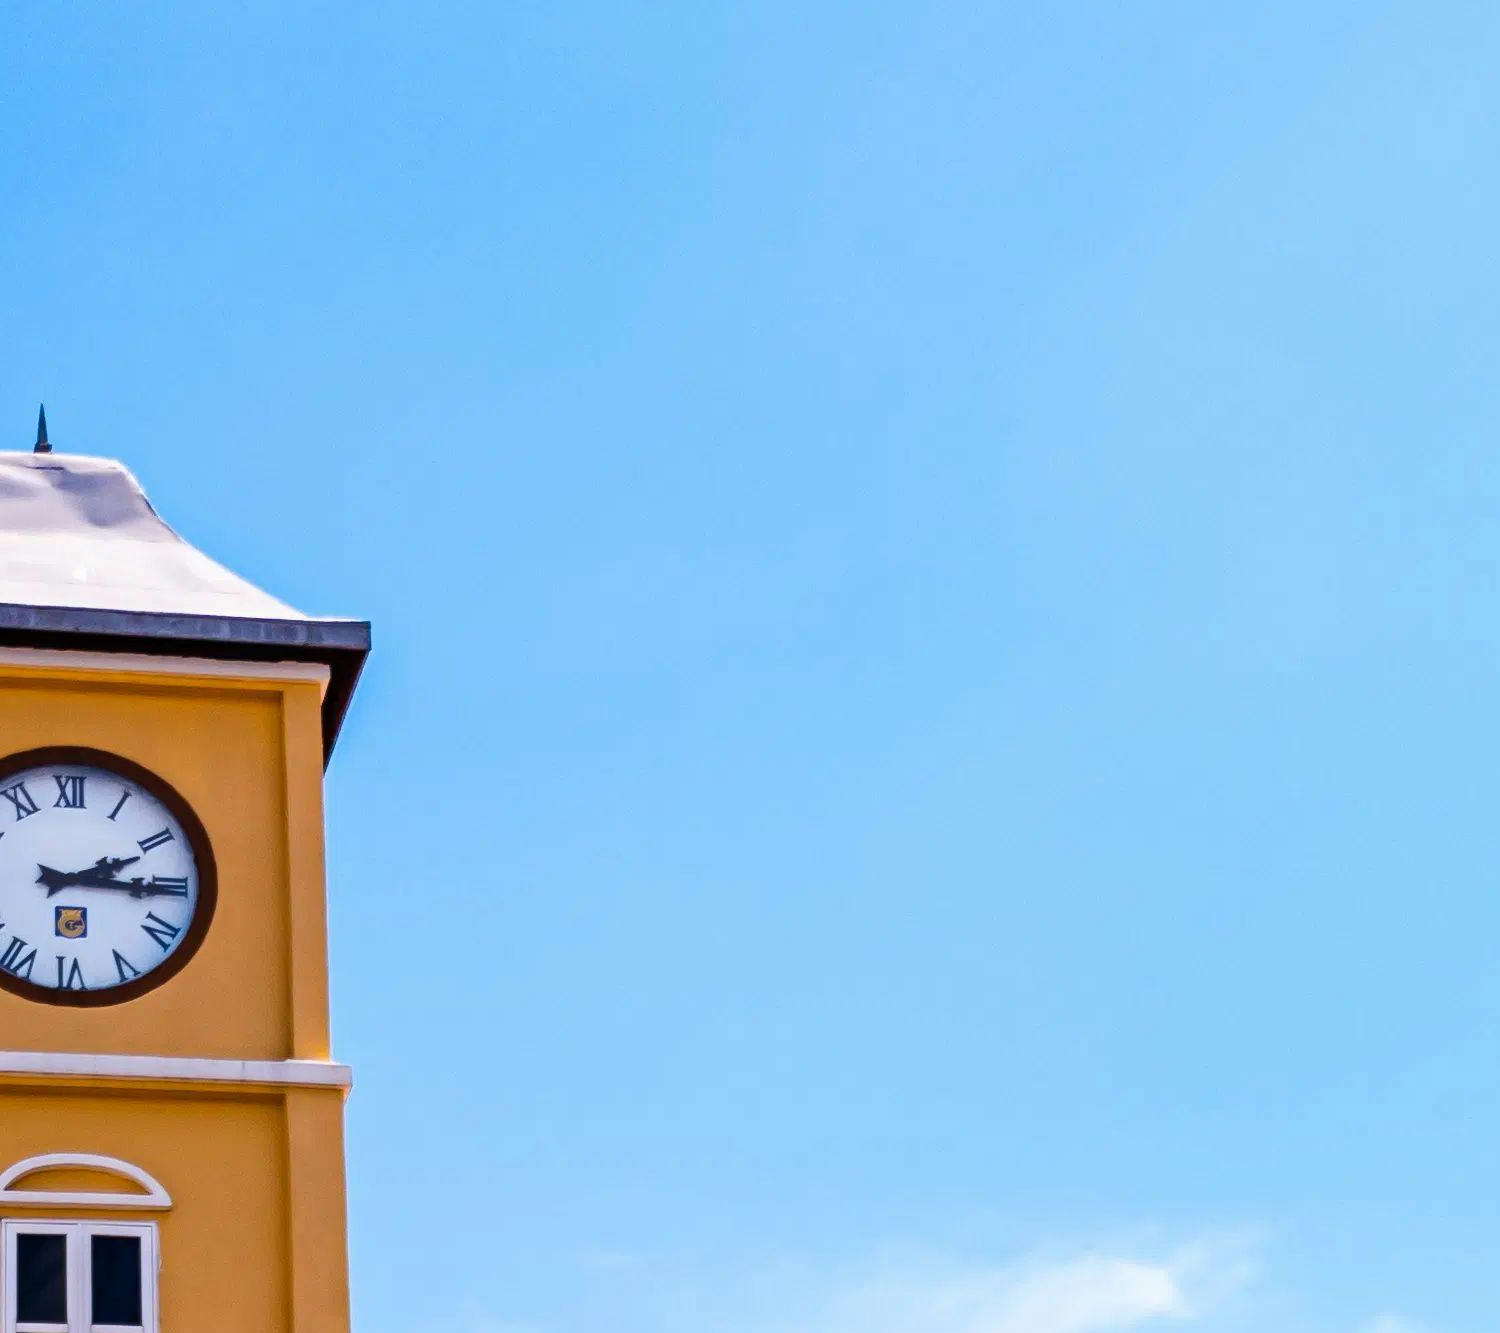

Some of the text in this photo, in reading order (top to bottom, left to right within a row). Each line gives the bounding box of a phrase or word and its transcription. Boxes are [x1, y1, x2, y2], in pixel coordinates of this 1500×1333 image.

[0, 781, 41, 821] XI
[53, 774, 87, 809] XII
[107, 790, 132, 822] I
[137, 827, 175, 854] II
[141, 911, 182, 953] IV
[55, 956, 88, 991] VI
[112, 948, 142, 983] V
